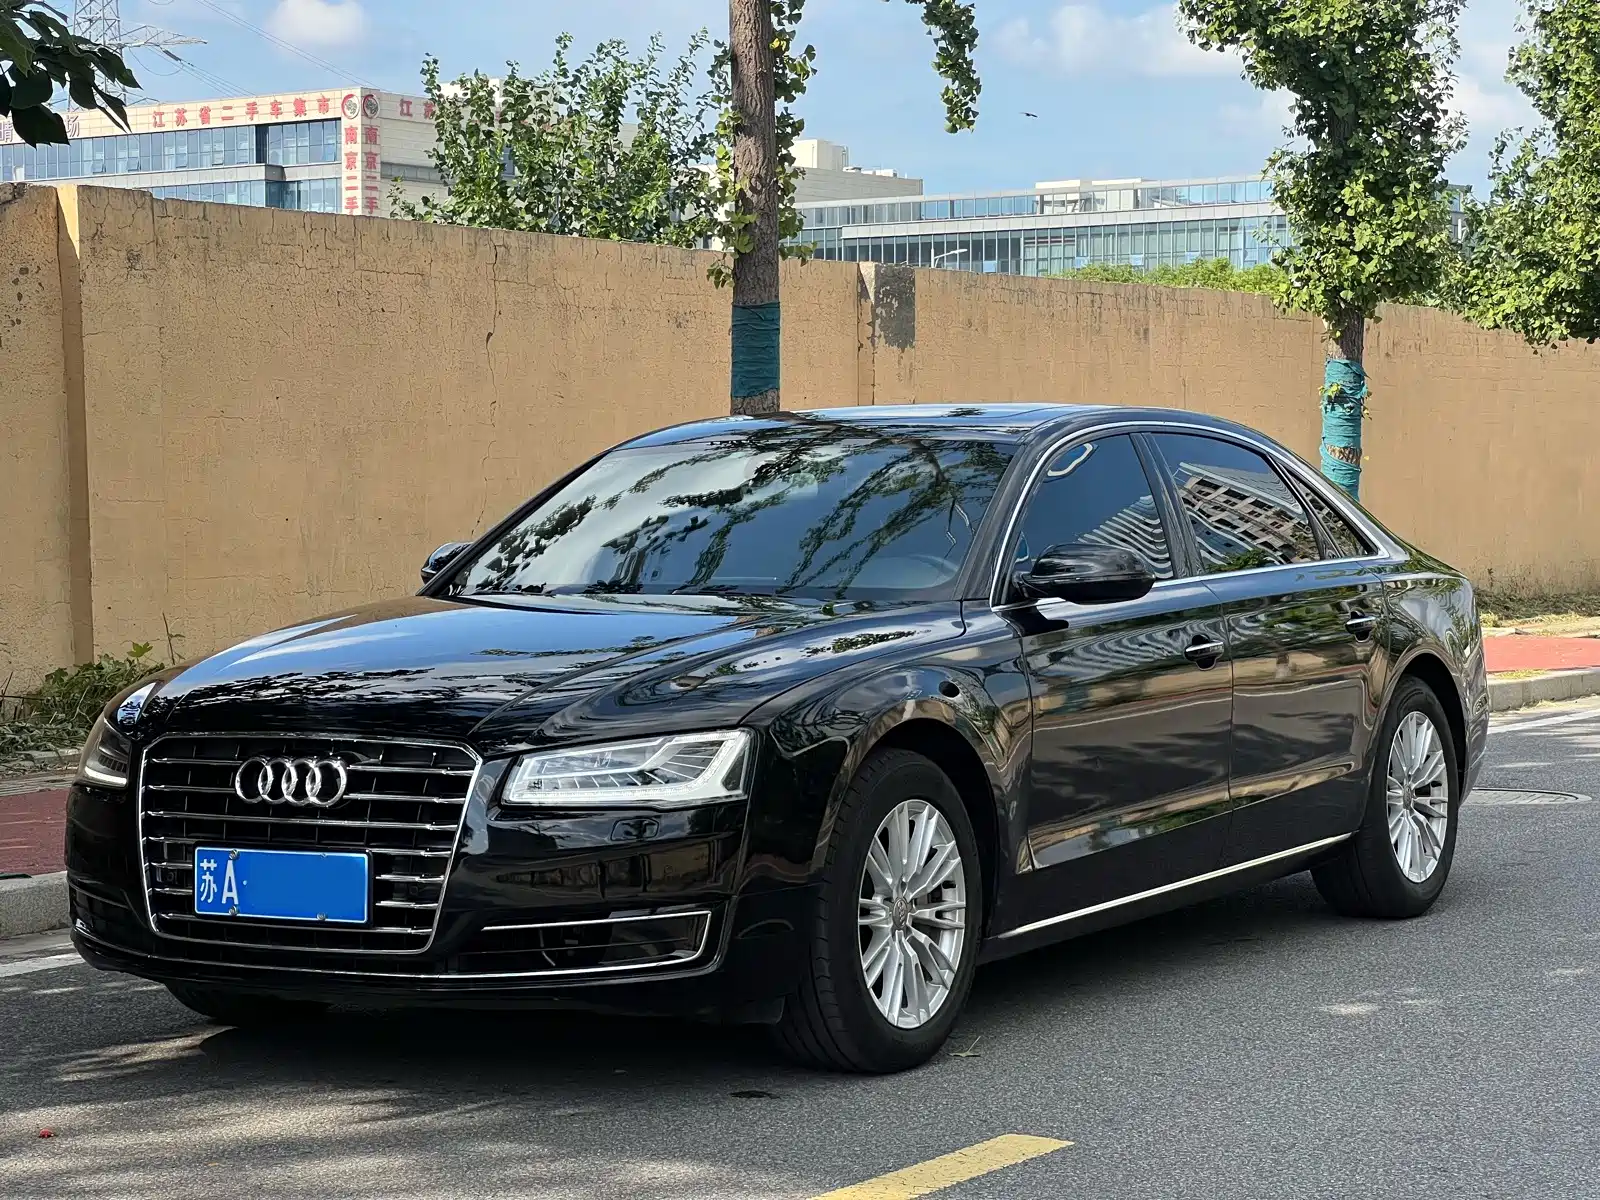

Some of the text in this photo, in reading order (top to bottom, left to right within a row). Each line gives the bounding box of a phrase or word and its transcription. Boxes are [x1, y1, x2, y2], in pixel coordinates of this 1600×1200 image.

[152, 93, 330, 128] 江苏省二手车集市
[344, 125, 359, 215] 南京二手
[364, 125, 379, 215] 南京二手
